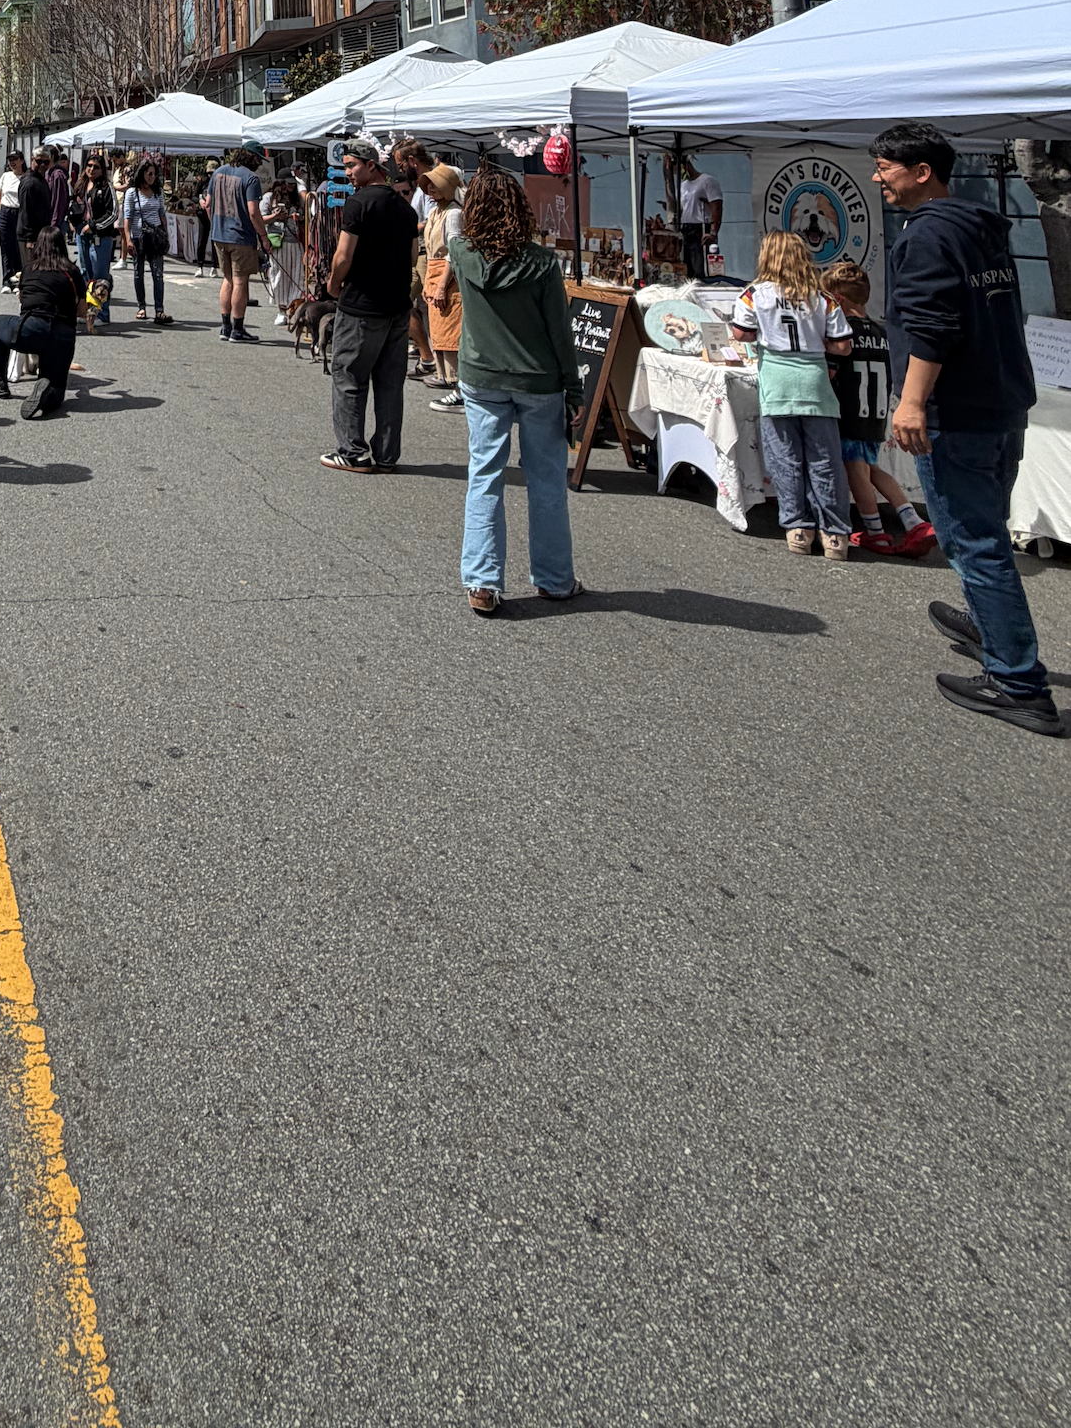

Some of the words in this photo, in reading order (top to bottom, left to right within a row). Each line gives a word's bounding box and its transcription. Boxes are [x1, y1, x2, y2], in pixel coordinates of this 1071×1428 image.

[768, 163, 805, 215] CODY'S
[812, 162, 865, 223] COOKIES
[581, 302, 602, 319] Live
[853, 360, 887, 419] 11
